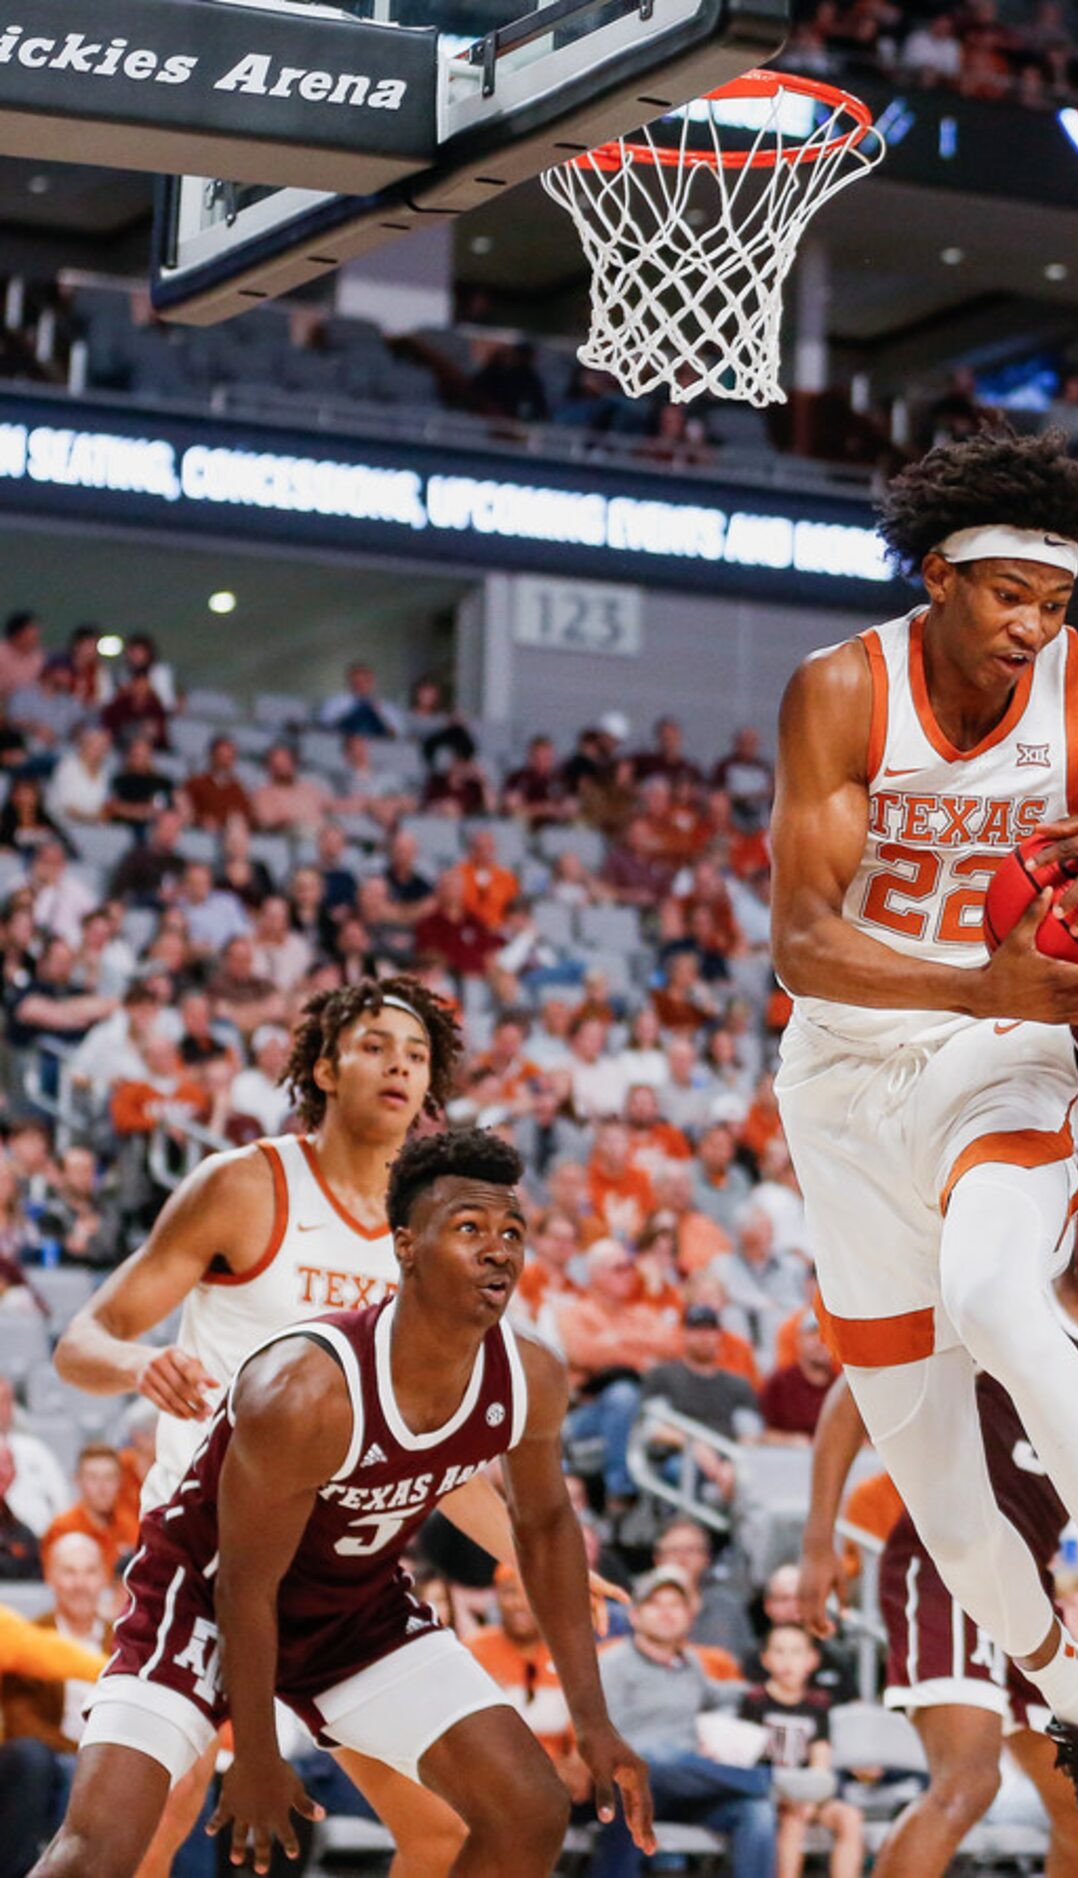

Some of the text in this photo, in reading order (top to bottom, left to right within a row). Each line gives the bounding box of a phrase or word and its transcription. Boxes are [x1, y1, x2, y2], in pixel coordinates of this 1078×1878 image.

[0, 25, 408, 110] ickies Arena
[534, 590, 623, 649] 123
[868, 790, 1049, 847] TEXAS
[858, 841, 1003, 945] 22
[297, 1264, 399, 1309] TEX
[319, 1472, 434, 1511] TEXAS
